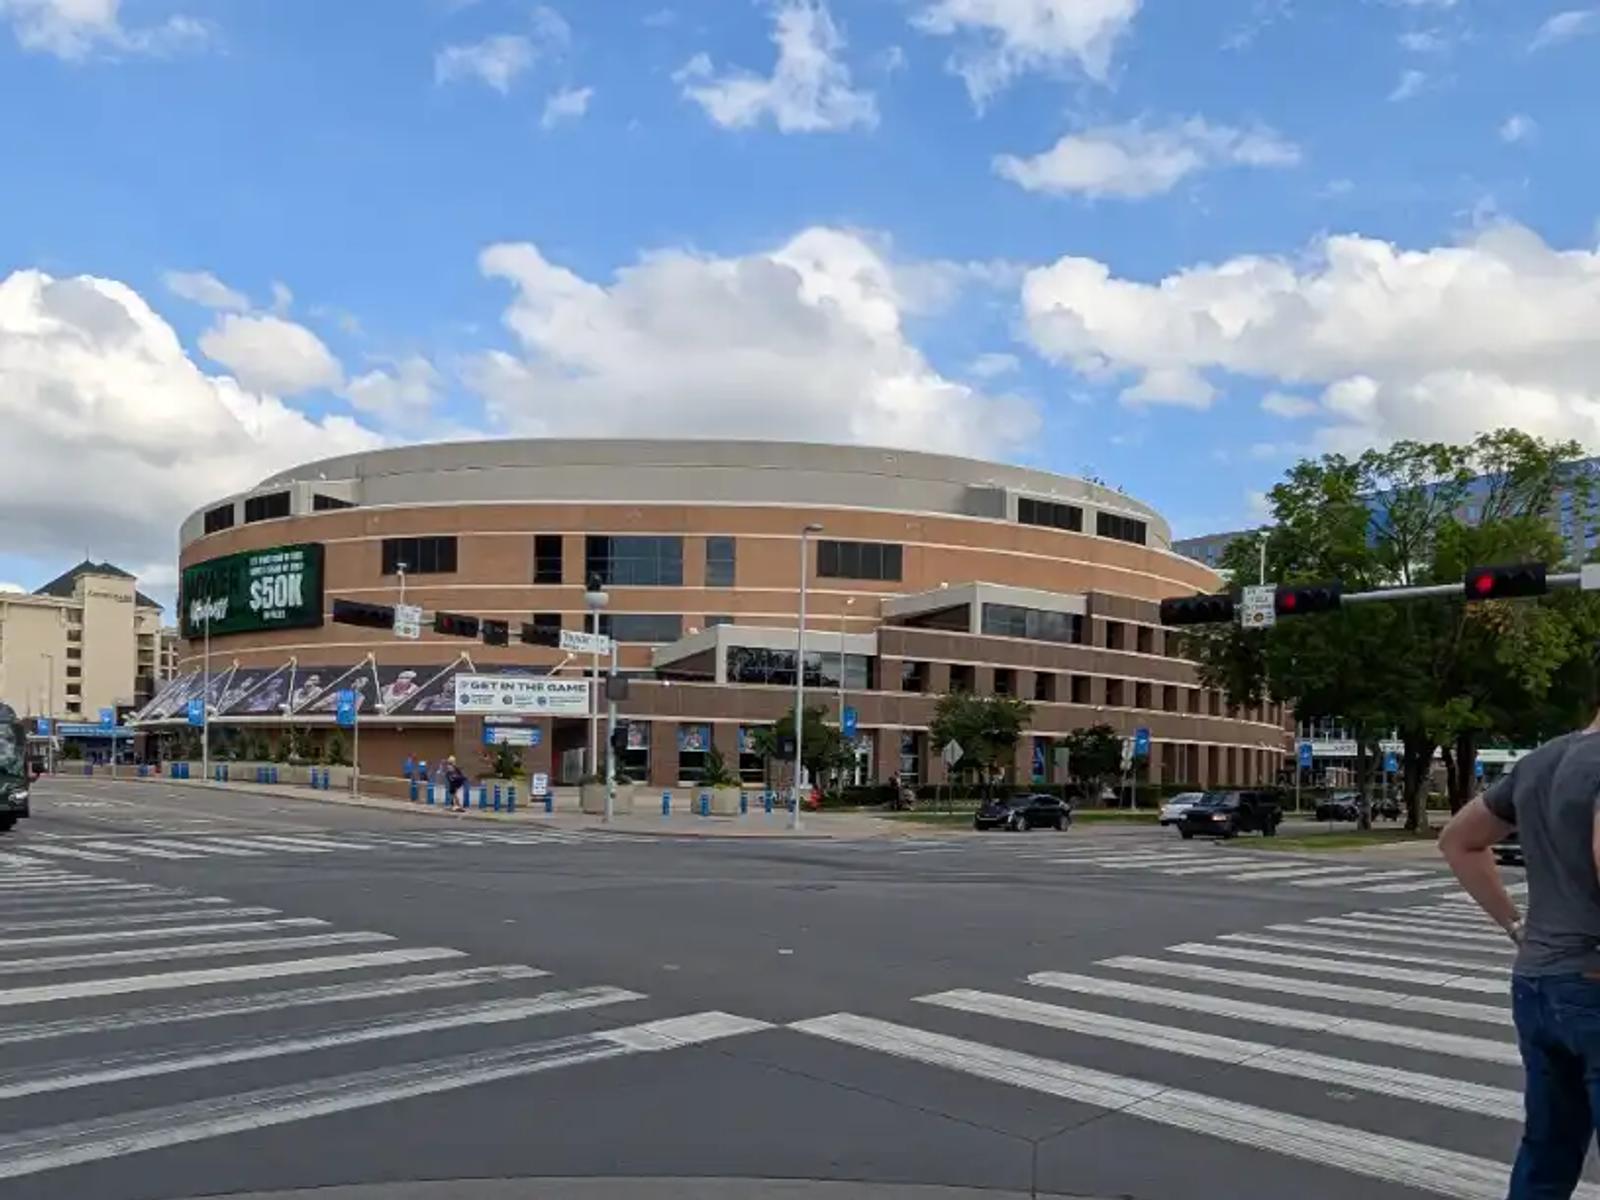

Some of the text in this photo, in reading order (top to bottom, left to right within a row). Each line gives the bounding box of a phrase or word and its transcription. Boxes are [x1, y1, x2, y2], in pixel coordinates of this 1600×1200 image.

[250, 573, 303, 610] $50K
[471, 681, 586, 692] GET IN THE GAME
